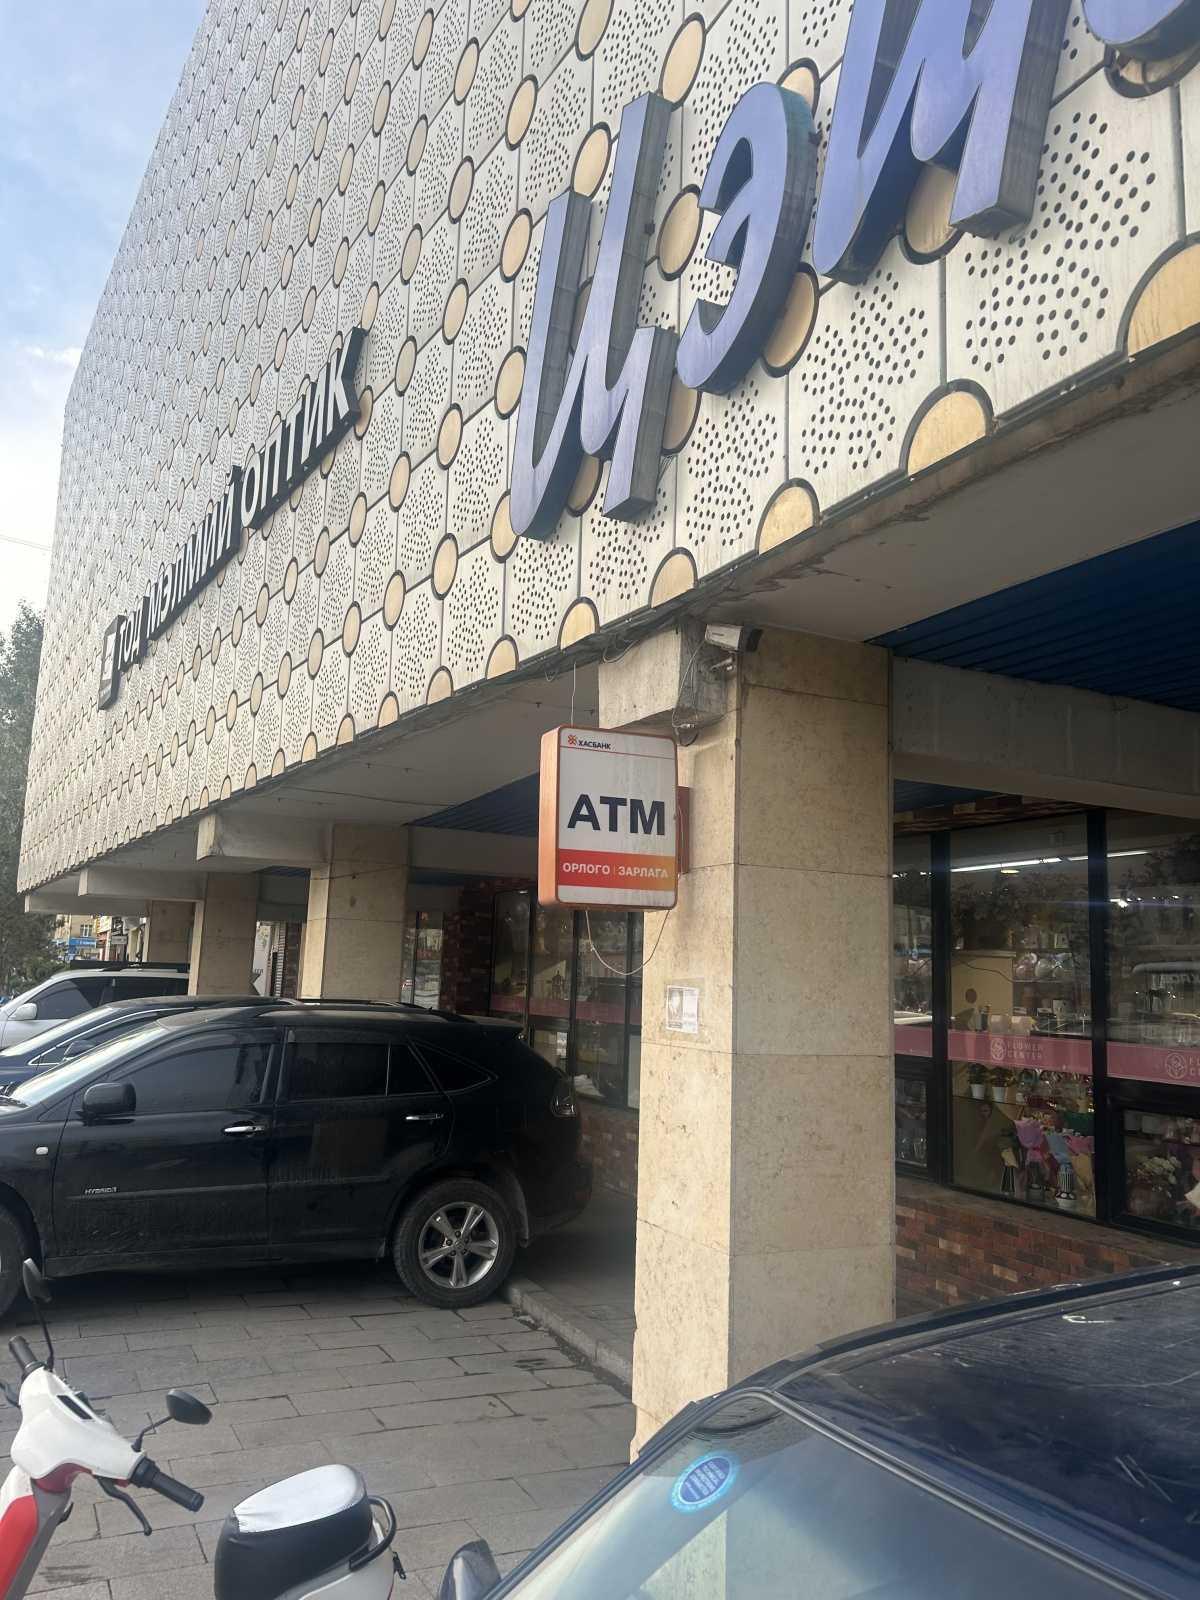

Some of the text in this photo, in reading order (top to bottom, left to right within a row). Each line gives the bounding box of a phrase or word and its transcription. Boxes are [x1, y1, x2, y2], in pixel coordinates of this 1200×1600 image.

[146, 473, 239, 640] МЭЛМИЙ
[240, 328, 356, 529] ОПТИК
[578, 740, 612, 750] ХАСБАНК
[562, 862, 669, 878] ОРЛОГО ЗАРЛАГА
